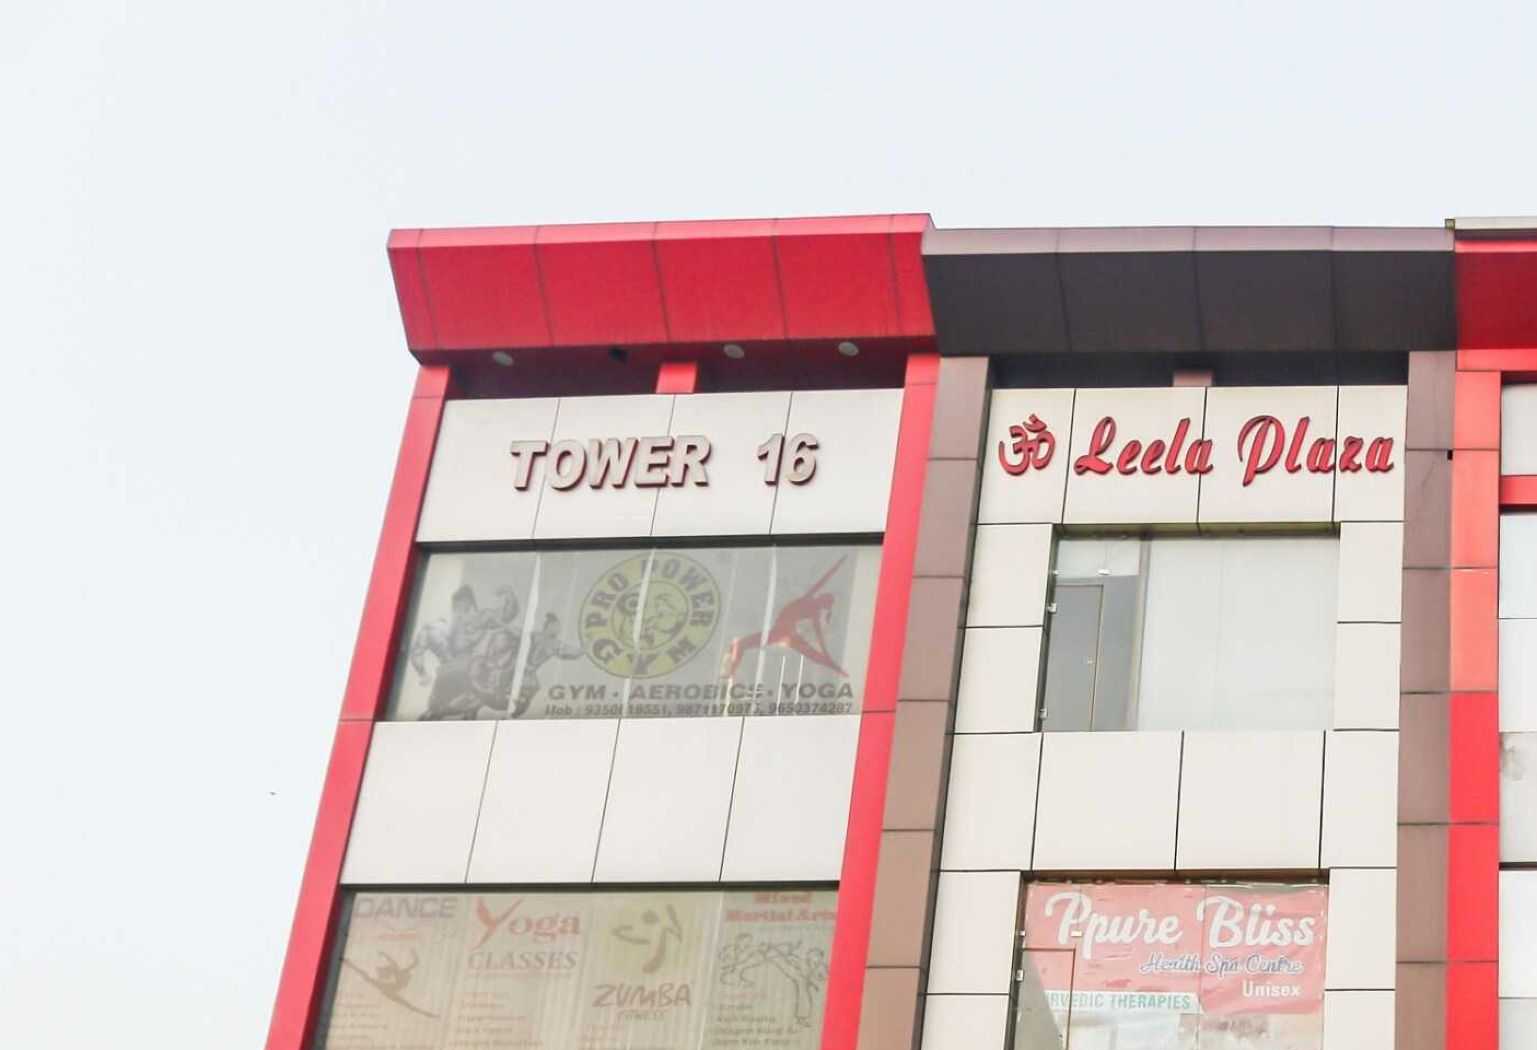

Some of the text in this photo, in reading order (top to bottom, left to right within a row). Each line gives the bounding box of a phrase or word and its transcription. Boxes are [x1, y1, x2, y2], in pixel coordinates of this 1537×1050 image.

[510, 432, 820, 492] TOWER 16
[1074, 414, 1395, 487] Leela Plaza
[549, 684, 607, 700] GYM
[782, 683, 854, 699] YOGA
[470, 896, 582, 951] Yoga
[1197, 895, 1317, 949] Bliss
[467, 950, 579, 971] CLASSES
[592, 982, 692, 1008] ZUMBA
[1110, 993, 1191, 1010] THERAPIES
[1242, 981, 1301, 998] Unisex
